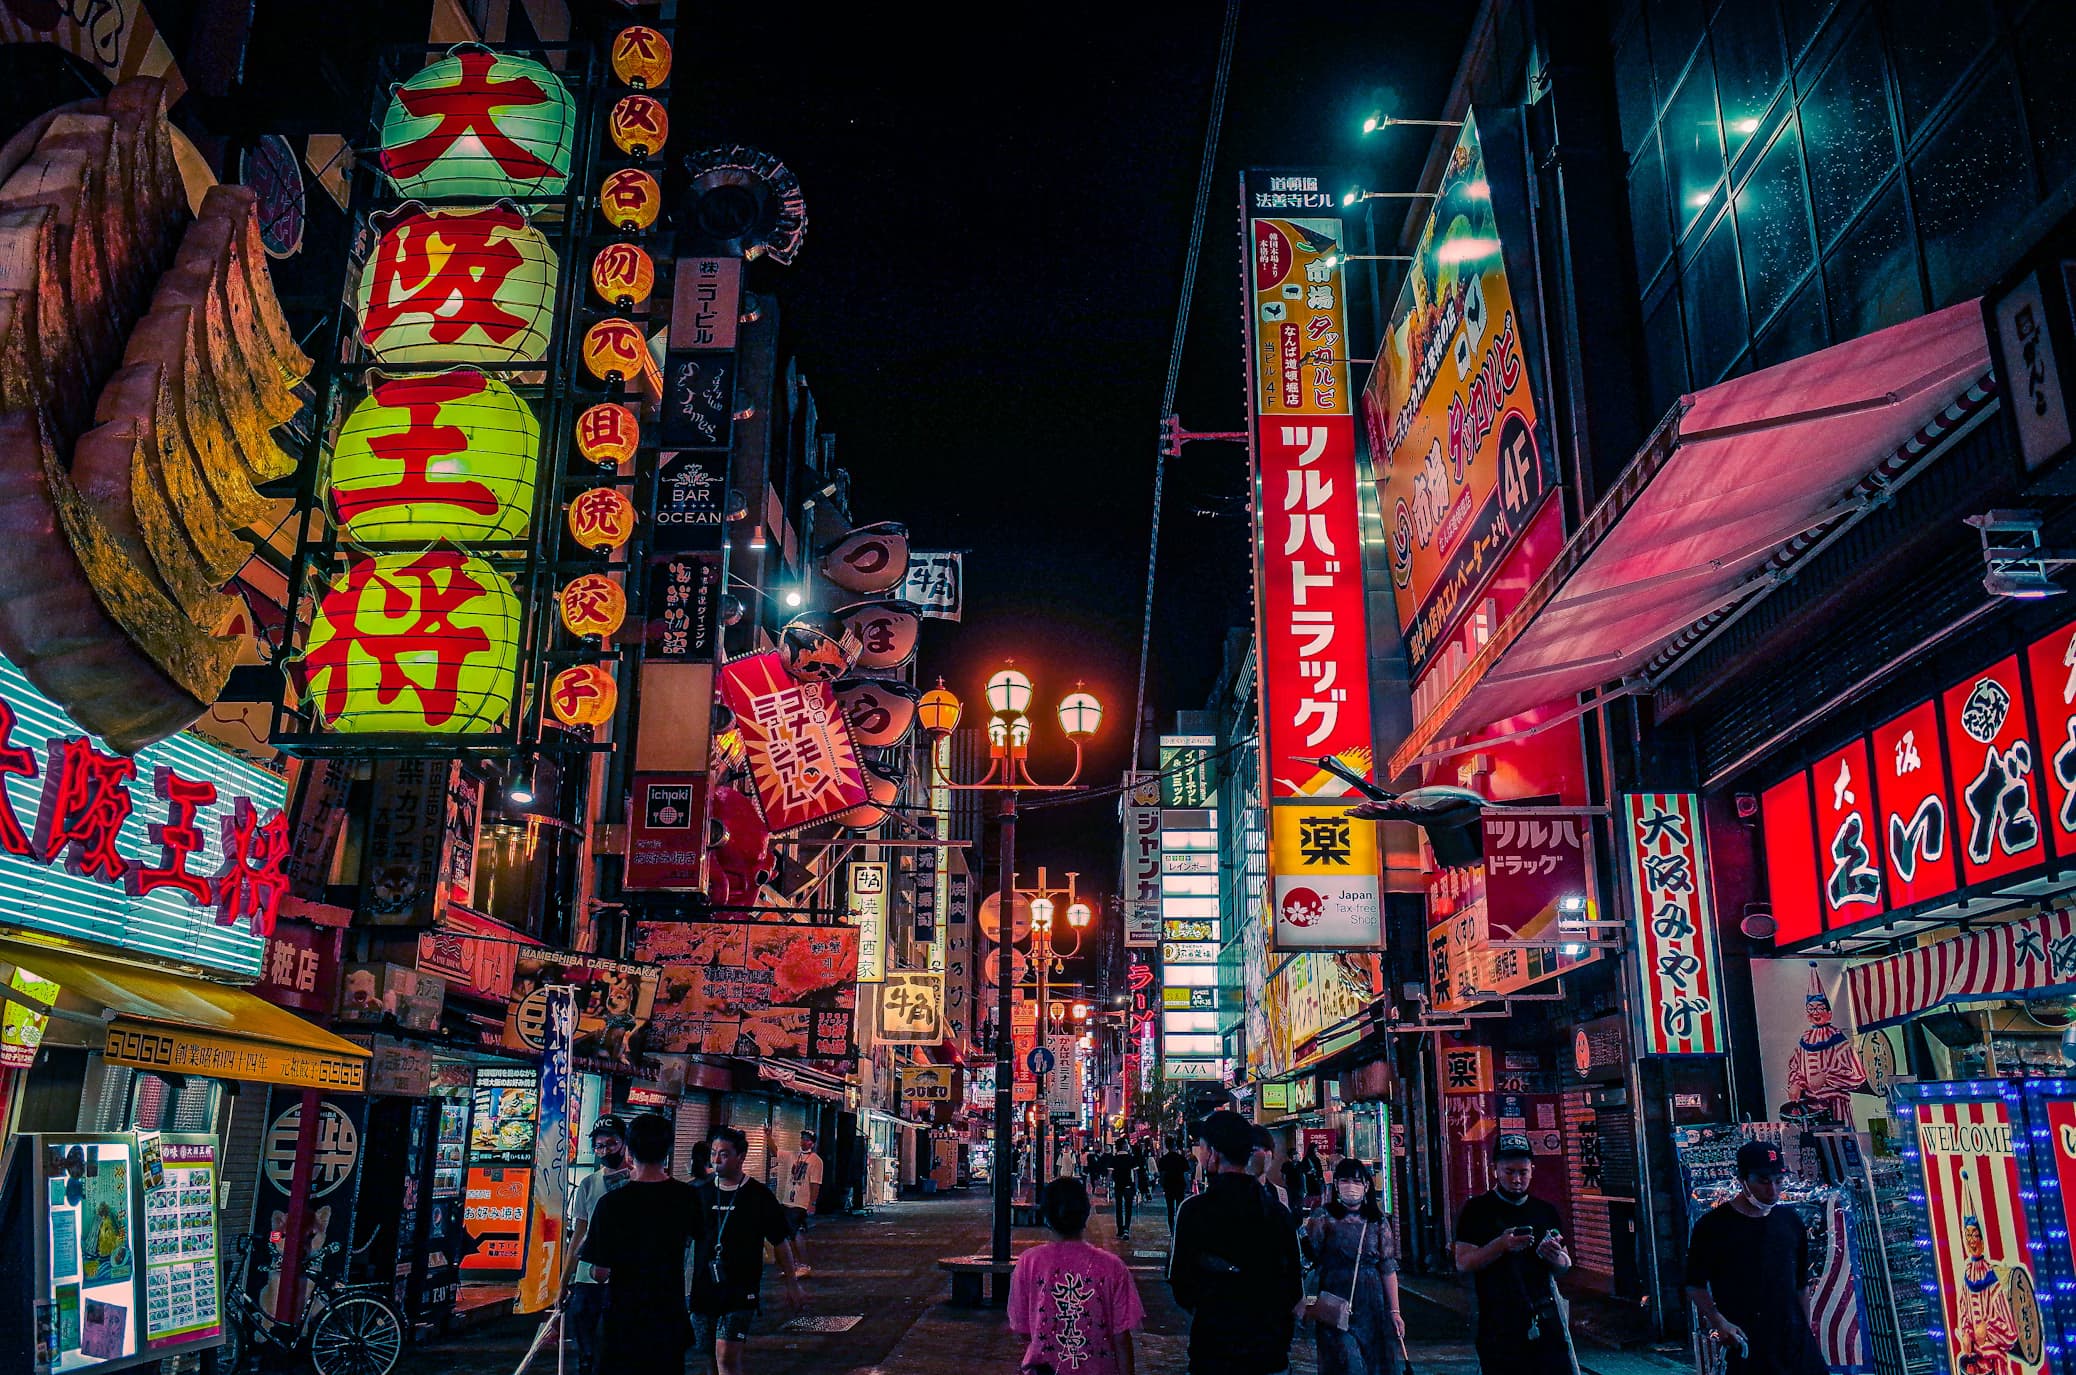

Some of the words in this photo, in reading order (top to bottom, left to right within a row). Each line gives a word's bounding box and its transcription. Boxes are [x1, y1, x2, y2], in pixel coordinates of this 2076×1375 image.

[1270, 176, 1318, 191] 道頓堀
[1256, 193, 1335, 208] 法善寺ビル
[1284, 325, 1301, 406] なんば道頓堀店
[1503, 429, 1531, 514] 4F
[673, 489, 711, 501] BAR
[656, 512, 722, 525] OCEAN
[1280, 425, 1347, 748] ツルハドラッグ
[1299, 816, 1351, 866] 薬
[1486, 820, 1581, 849] ツルハ
[858, 871, 881, 888] 牛角
[1169, 862, 1208, 871] レインボー
[1489, 854, 1564, 876] ドラッグ
[1350, 914, 1377, 926] Shop
[1455, 914, 1475, 946] くすり
[1638, 807, 1711, 1041] 大阪みやげ
[261, 937, 319, 994] 粧店
[521, 949, 584, 967] MAMESHIBA
[587, 959, 617, 972] CAFE
[619, 964, 658, 978] OSAKA
[1431, 934, 1452, 1006] 薬
[885, 987, 934, 1026] 牛角
[174, 1040, 269, 1075] 創業昭和四十四年
[1173, 1064, 1207, 1074] ZAZA
[1447, 1051, 1478, 1088] 薬
[1921, 1124, 2014, 1154] WELCOME
[463, 1206, 524, 1221] お好み焼き
